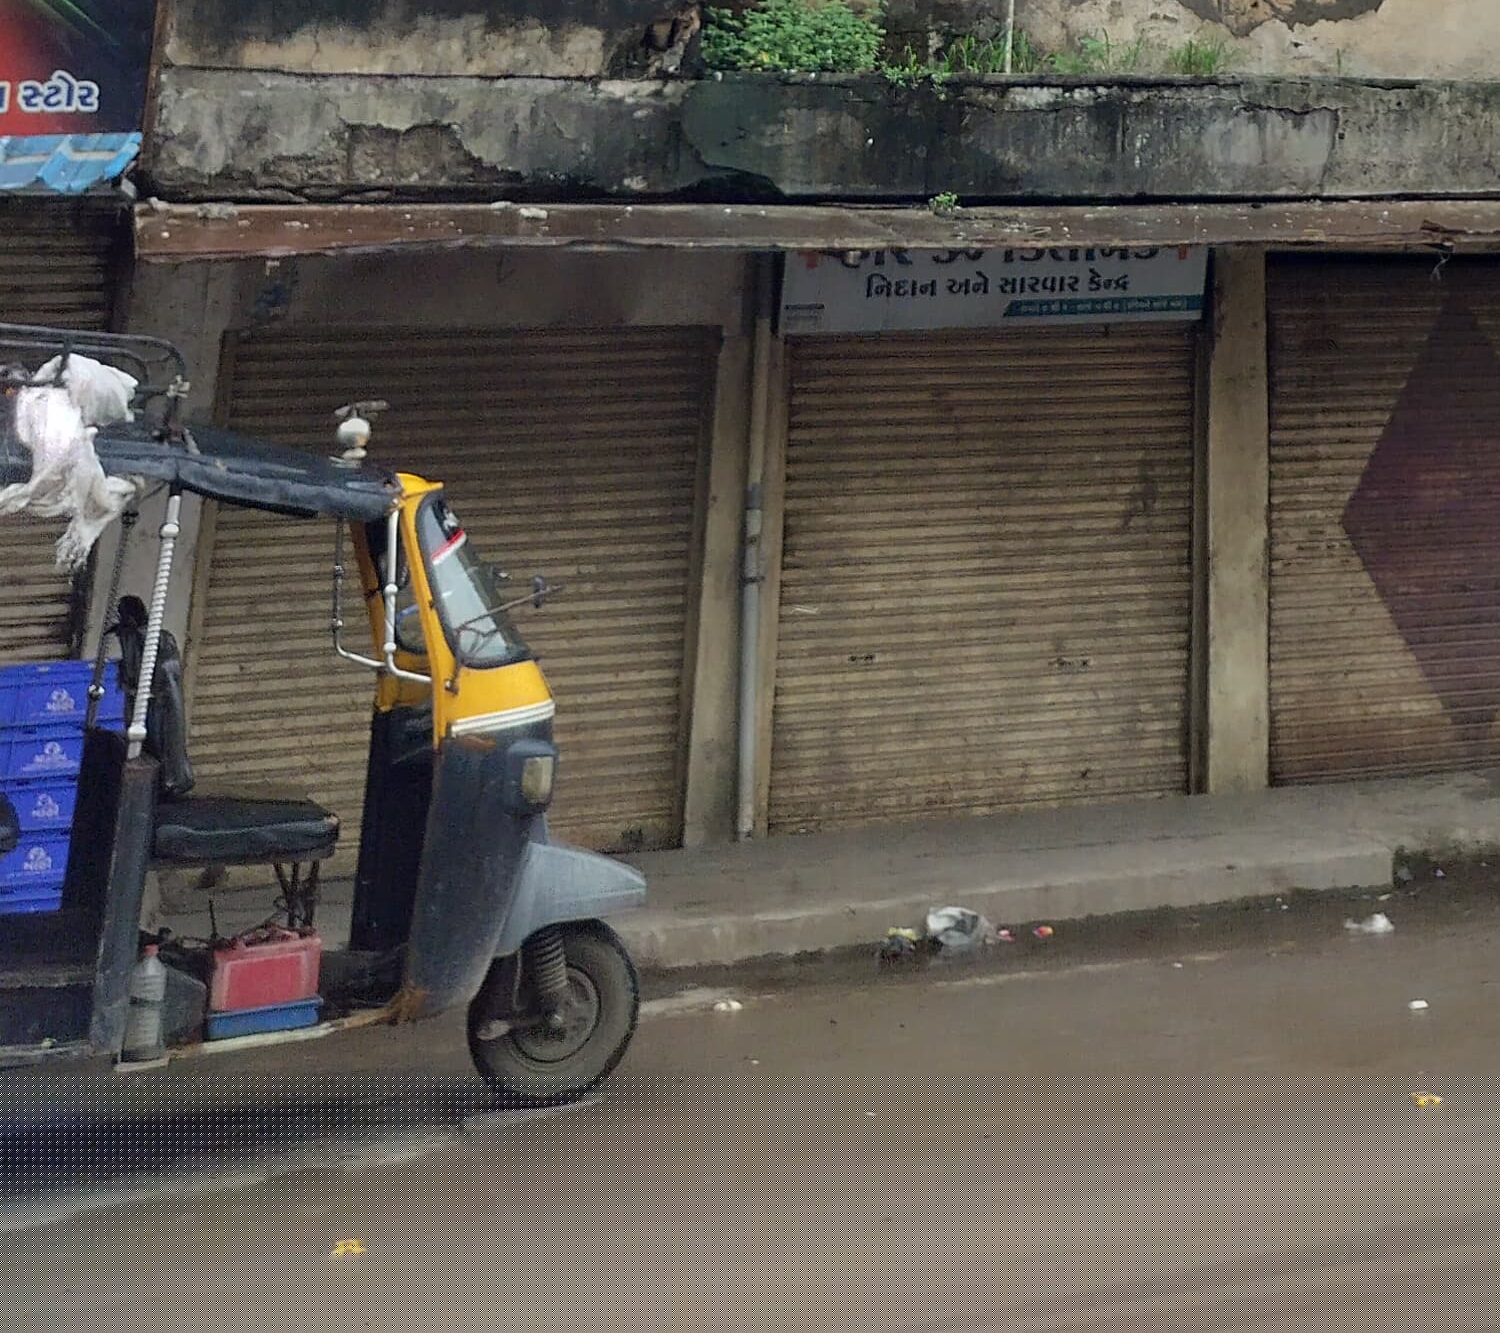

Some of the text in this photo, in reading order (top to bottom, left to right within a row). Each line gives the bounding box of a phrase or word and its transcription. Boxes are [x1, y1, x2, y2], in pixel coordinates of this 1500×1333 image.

[18, 70, 99, 112] સ્ટોર
[865, 267, 1131, 298] નિદાન અને સારવાર કેન્દ્ર
